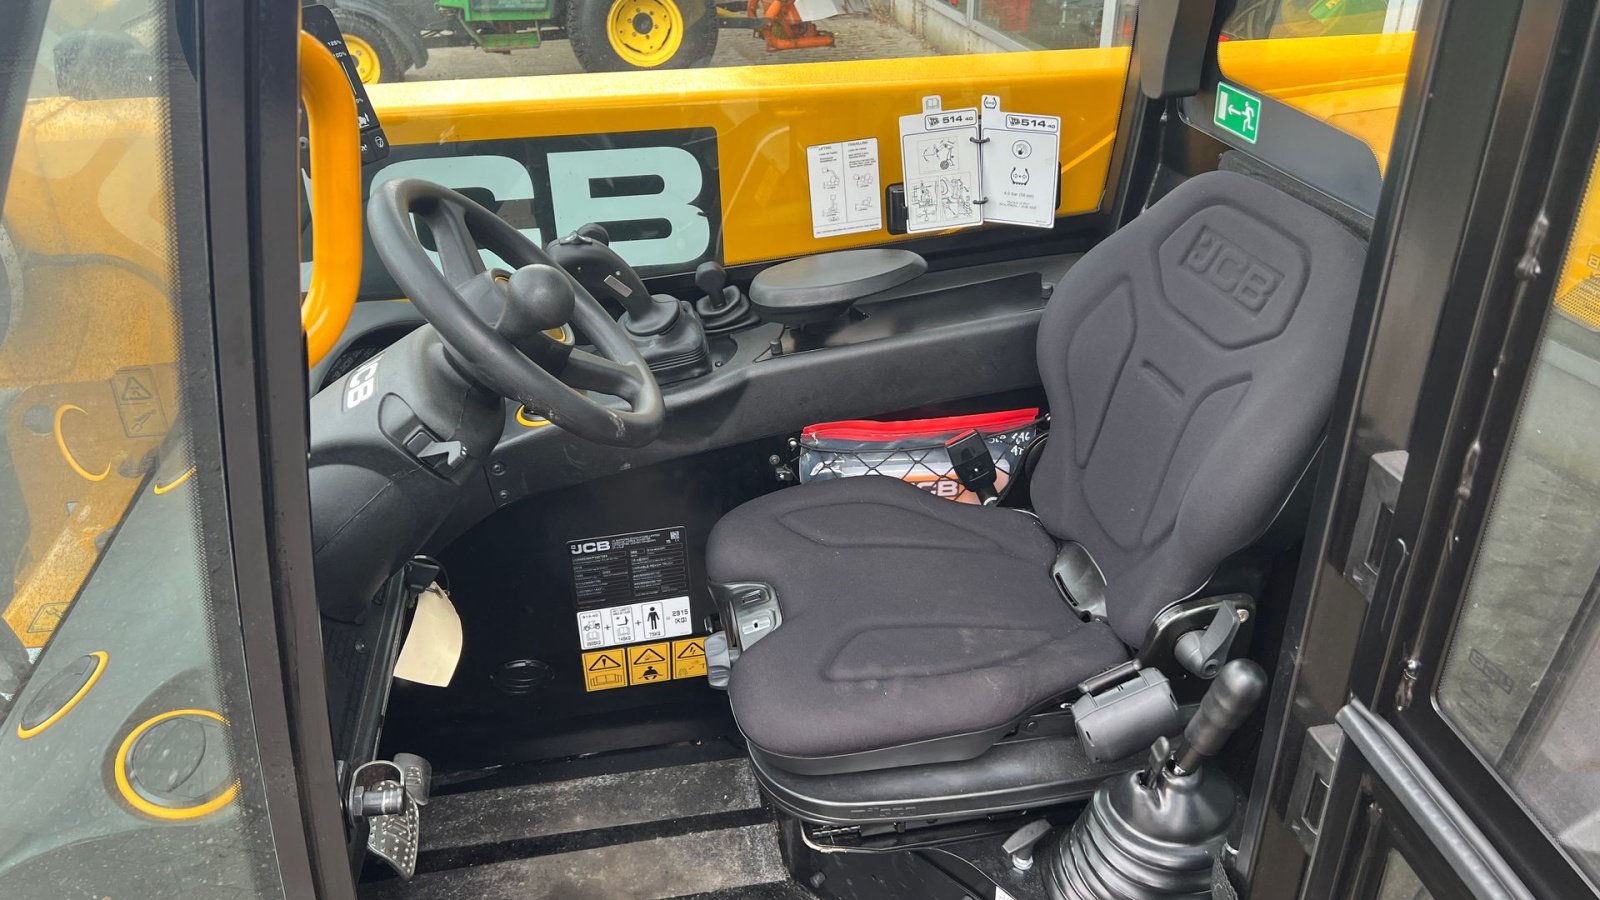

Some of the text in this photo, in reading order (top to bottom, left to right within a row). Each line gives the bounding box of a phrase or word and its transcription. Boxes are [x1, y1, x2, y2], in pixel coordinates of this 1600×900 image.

[942, 115, 963, 124] 514
[1021, 118, 1046, 128] 514
[301, 146, 710, 293] CB
[1183, 230, 1278, 312] JCB
[347, 353, 385, 409] CB
[570, 540, 611, 555] JCB
